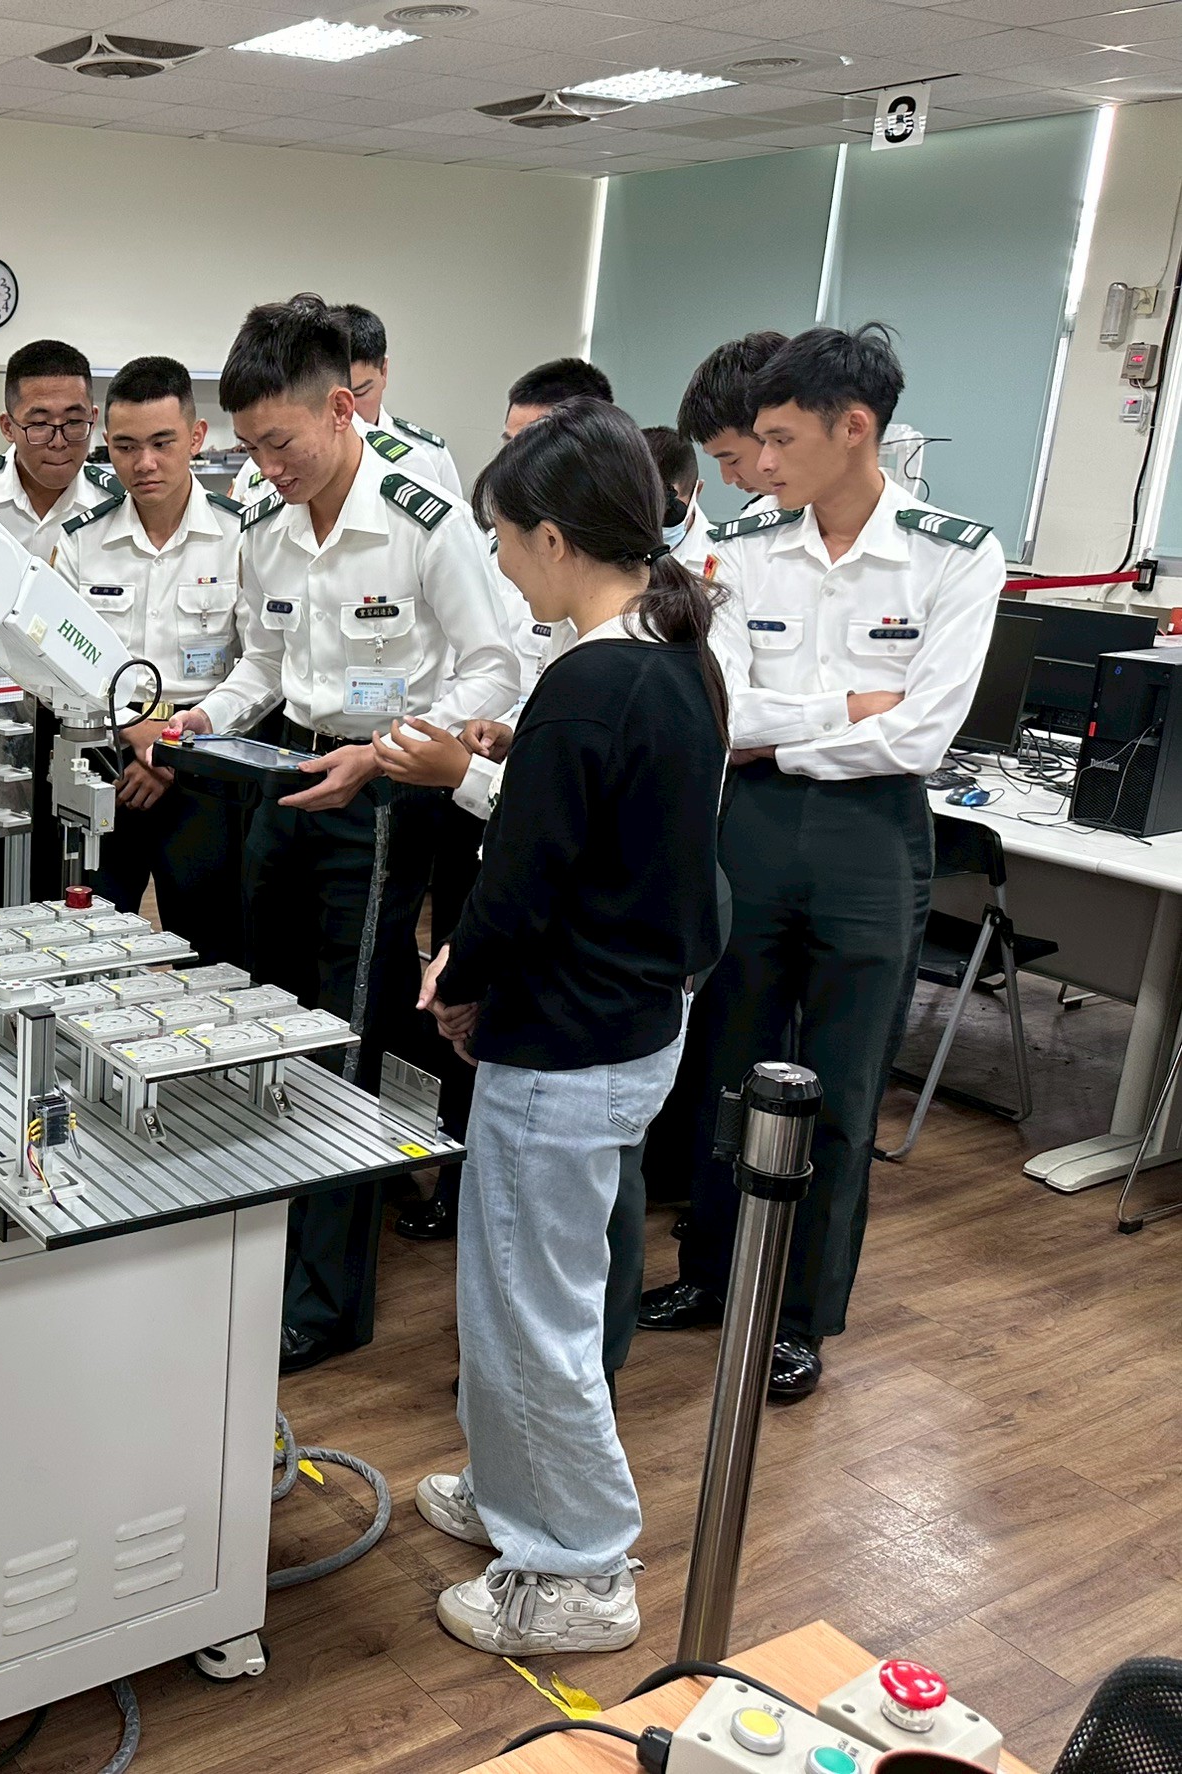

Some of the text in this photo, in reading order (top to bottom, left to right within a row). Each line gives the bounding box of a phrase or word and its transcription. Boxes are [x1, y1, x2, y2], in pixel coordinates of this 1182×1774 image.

[0, 277, 7, 287] 2
[4, 285, 11, 301] 3
[2, 300, 10, 313] 4
[56, 618, 102, 666] HIWIN
